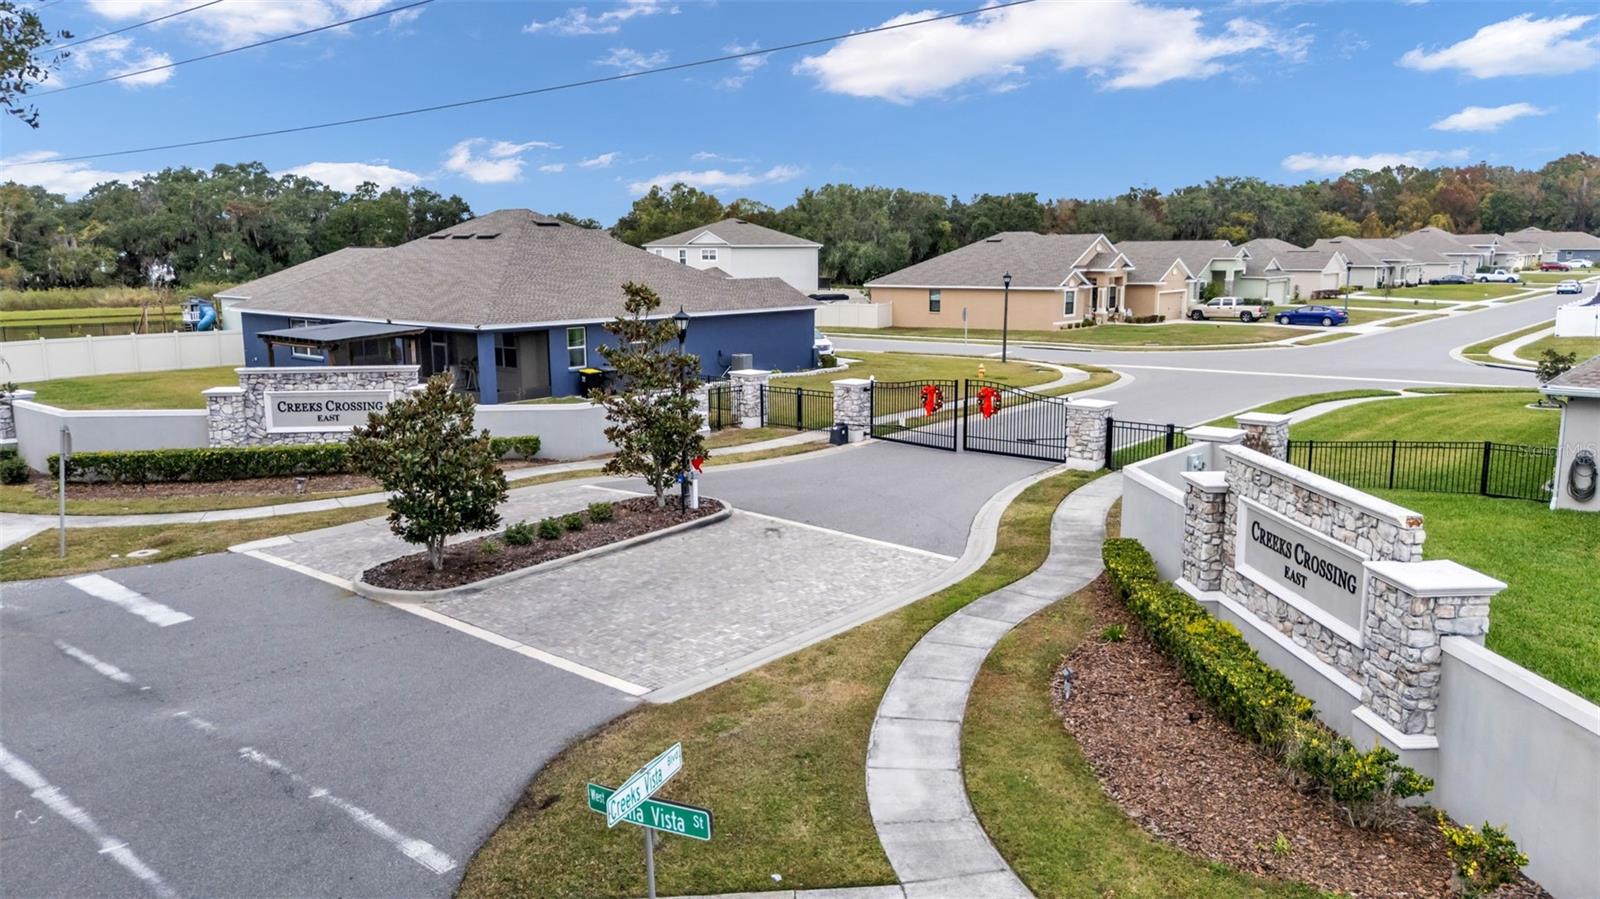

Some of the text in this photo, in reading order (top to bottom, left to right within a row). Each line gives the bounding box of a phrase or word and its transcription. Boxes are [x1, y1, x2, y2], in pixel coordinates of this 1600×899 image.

[277, 400, 383, 413] CREEKS CROSSING
[317, 414, 340, 422] EAST
[1251, 520, 1357, 595] CREEKS CROSSING
[1284, 565, 1307, 589] EAST
[610, 751, 679, 820] Creeks Vista Blvd
[590, 788, 605, 805] West
[651, 806, 685, 833] Vista
[693, 814, 704, 830] St
